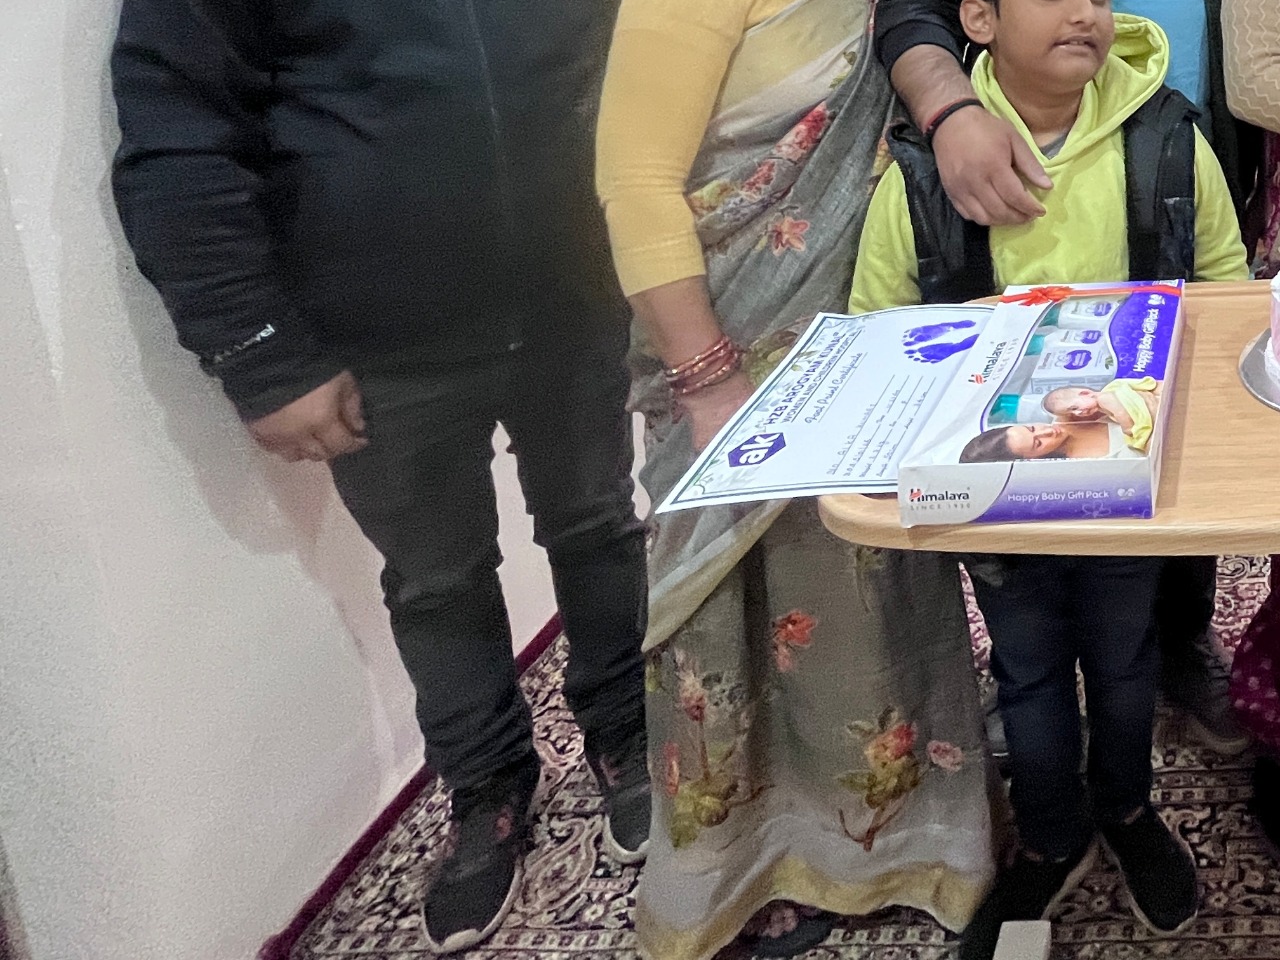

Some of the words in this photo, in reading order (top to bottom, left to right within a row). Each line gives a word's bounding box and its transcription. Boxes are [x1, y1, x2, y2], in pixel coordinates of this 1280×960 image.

[765, 405, 788, 426] HZB
[782, 360, 823, 404] AROGYAM
[781, 397, 804, 424] WOMEN
[910, 488, 970, 503] Himalaya
[1007, 493, 1040, 503] Happy
[1041, 492, 1066, 502] Baby
[1067, 490, 1085, 500] Gift
[1086, 489, 1110, 499] Pack
